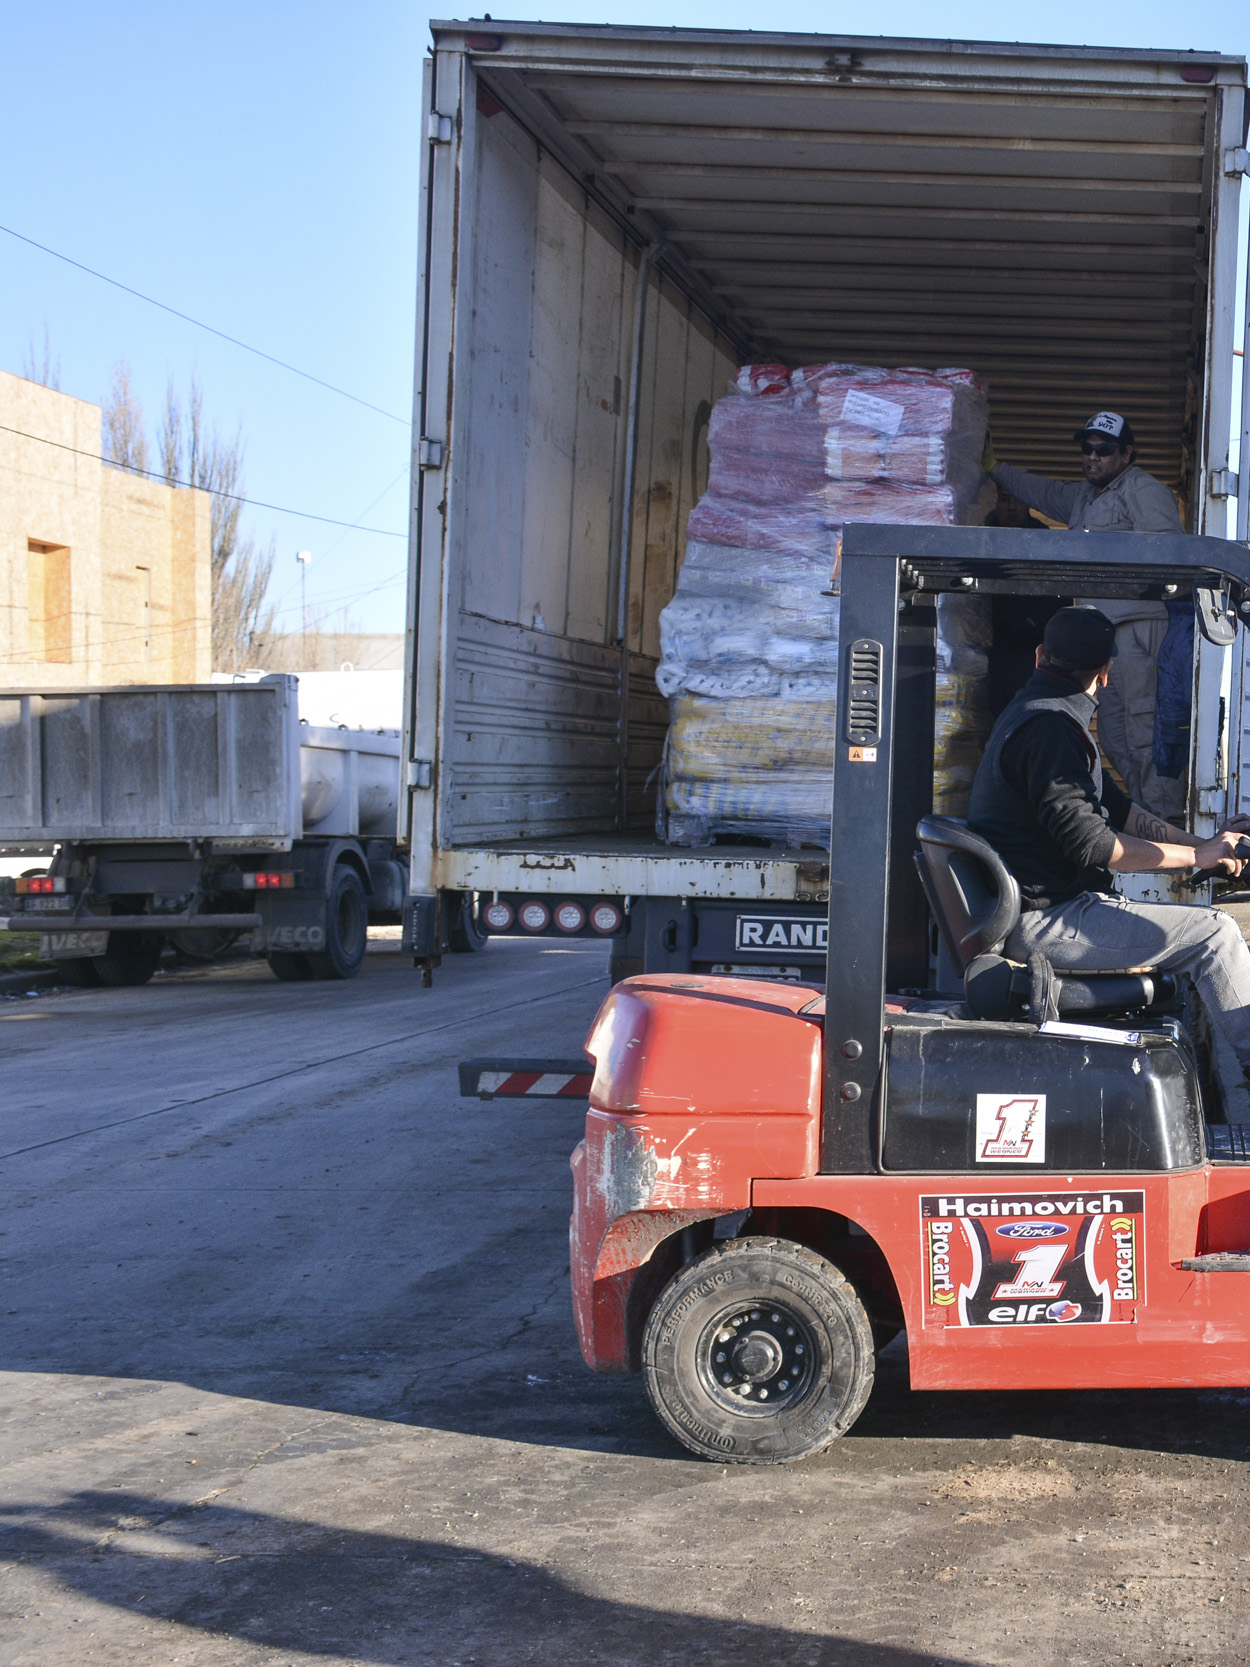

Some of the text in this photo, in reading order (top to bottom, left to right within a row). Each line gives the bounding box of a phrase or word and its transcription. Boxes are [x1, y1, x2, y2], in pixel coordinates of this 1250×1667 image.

[938, 1194, 1124, 1216] Haimovich
[1009, 1224, 1056, 1237] Ford
[931, 1222, 955, 1291] Brocart
[990, 1244, 1070, 1300] 1
[1112, 1232, 1134, 1300] Brocart
[663, 1270, 734, 1346] PERFORMANCE
[988, 1304, 1046, 1322] elf
